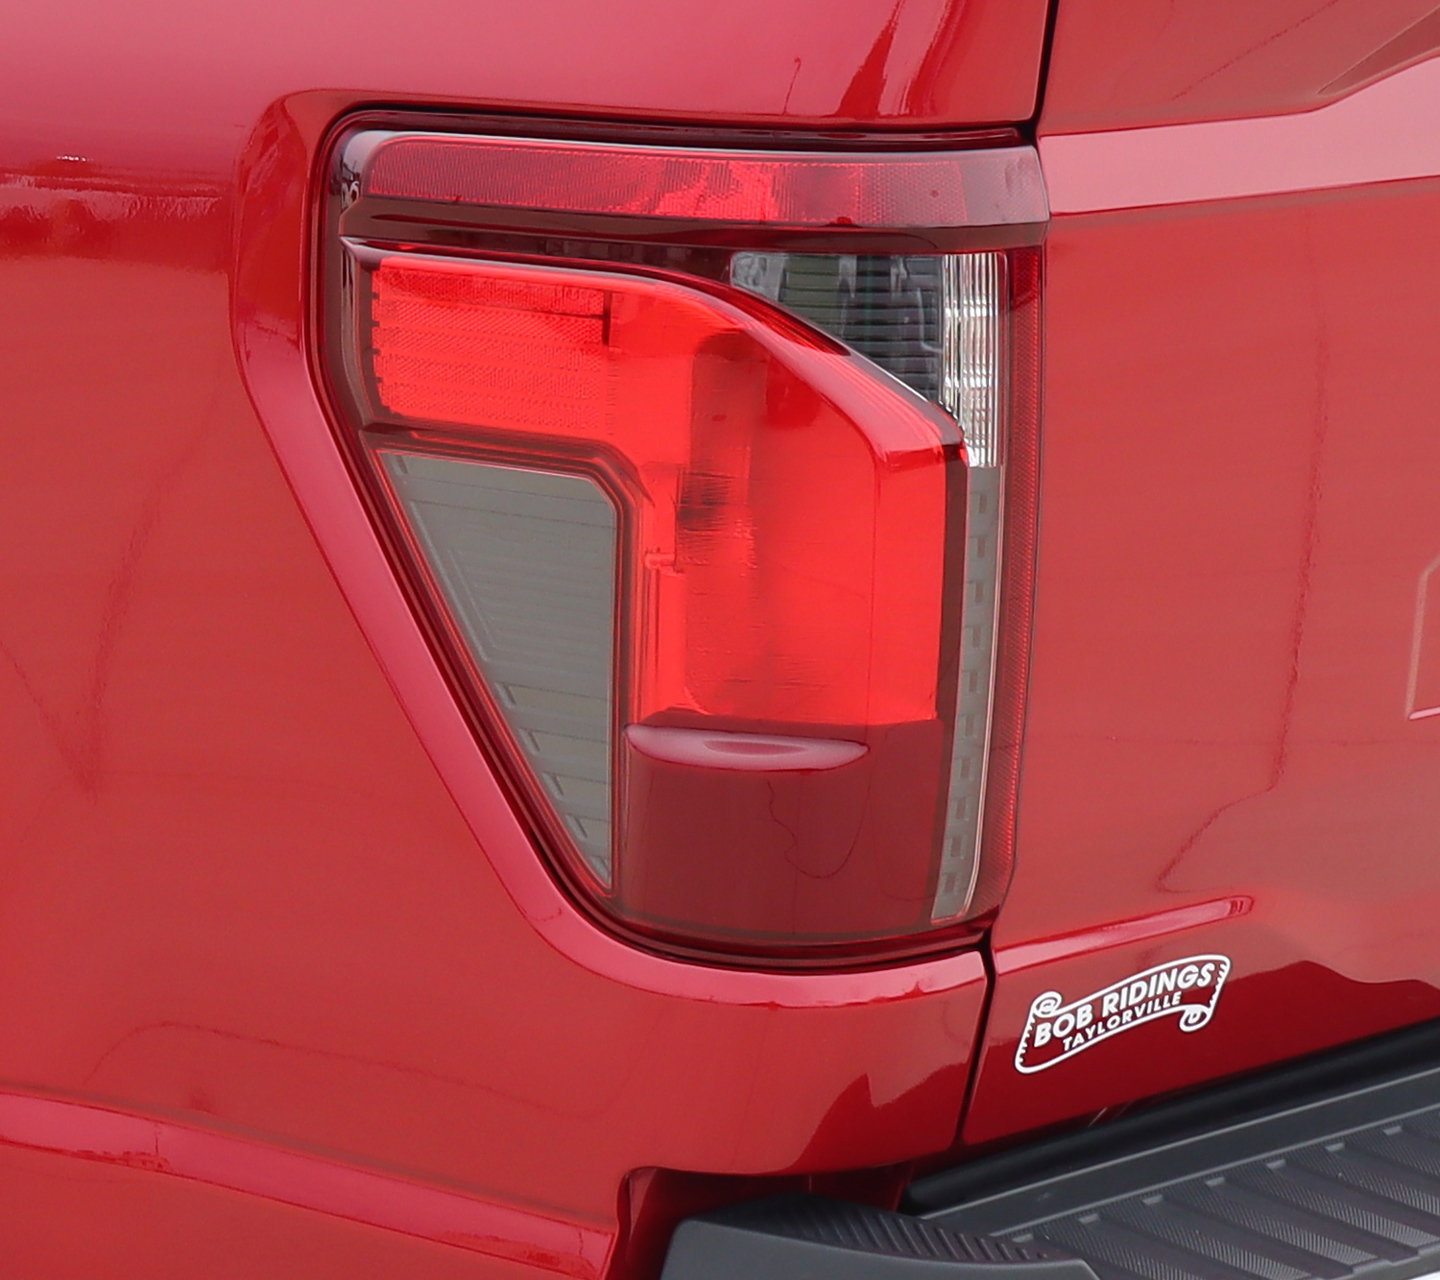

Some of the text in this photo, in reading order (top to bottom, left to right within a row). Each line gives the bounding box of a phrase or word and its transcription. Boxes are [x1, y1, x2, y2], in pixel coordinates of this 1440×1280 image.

[1033, 962, 1216, 1048] BOB RIDINGS
[1062, 991, 1182, 1052] TAYLORVILLE
